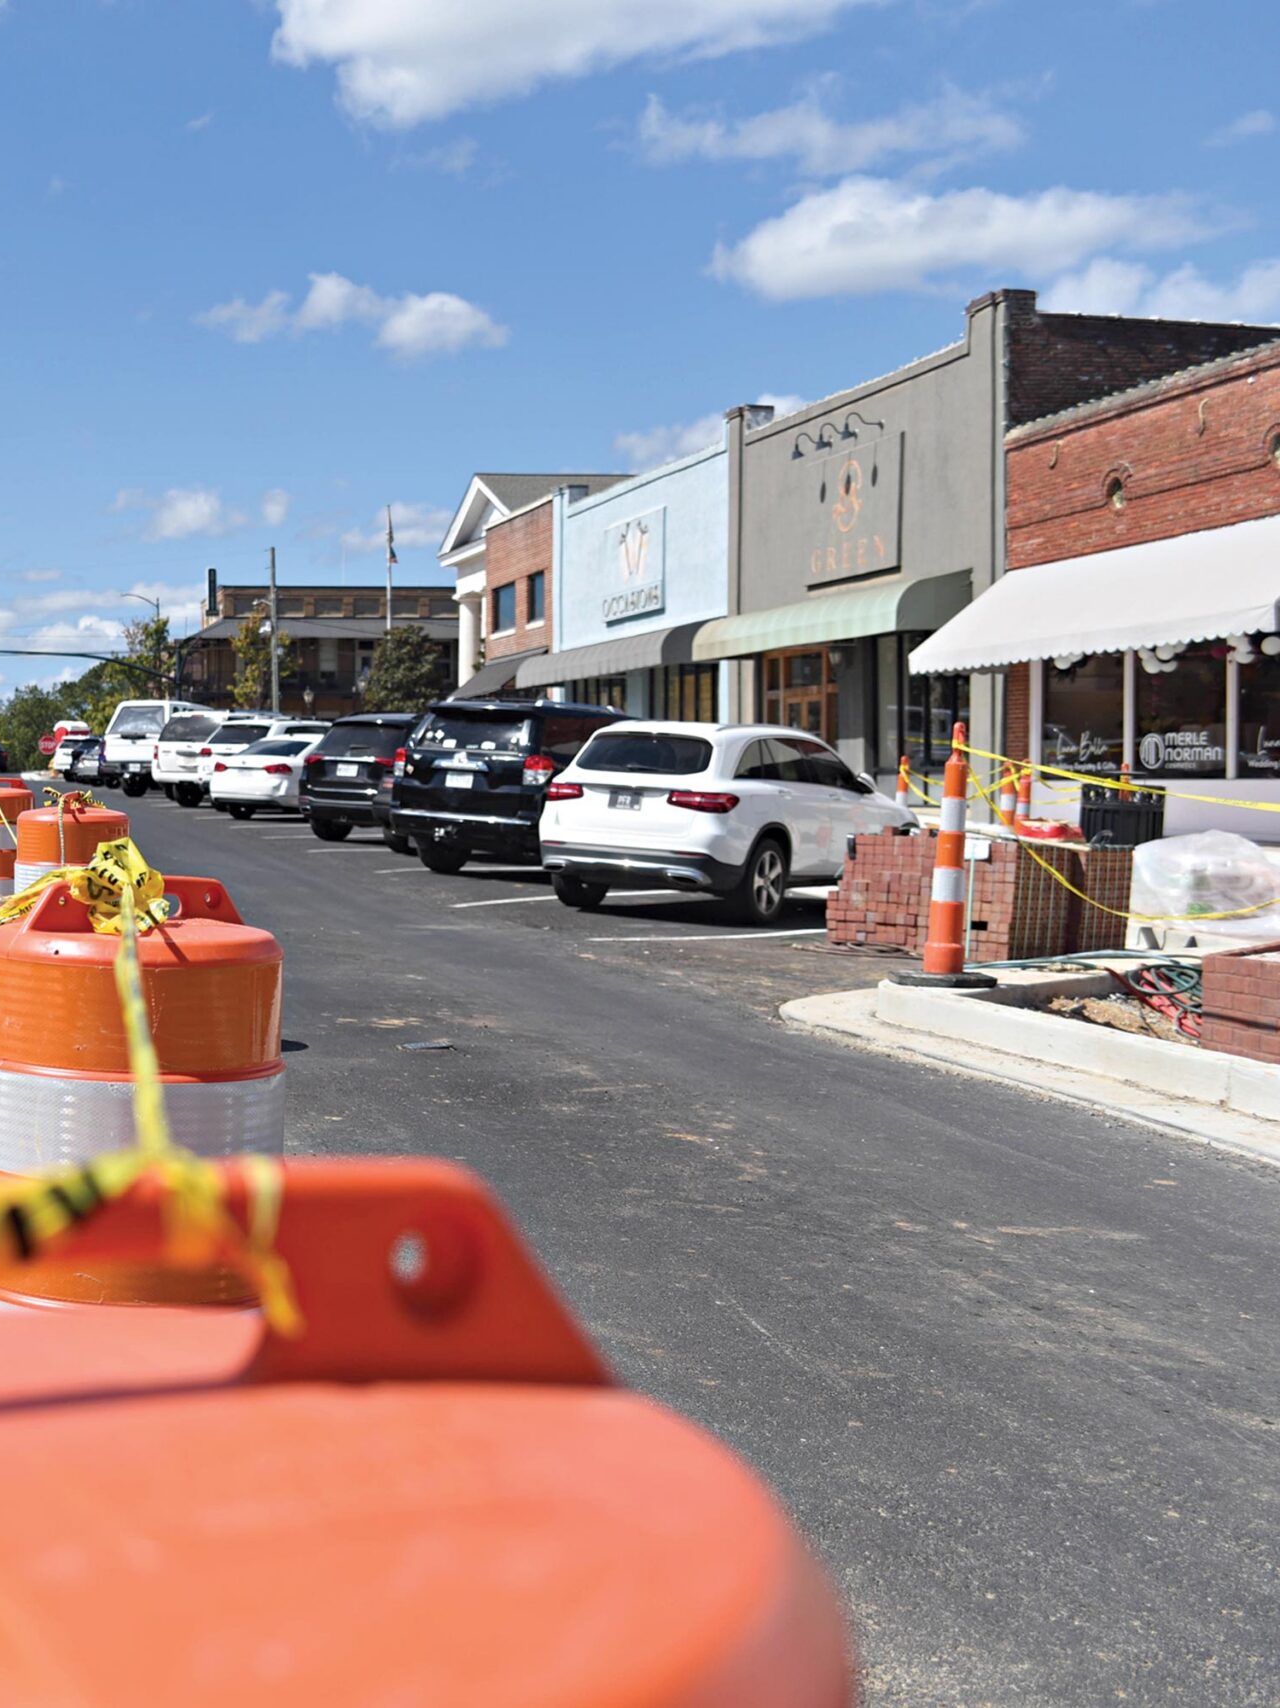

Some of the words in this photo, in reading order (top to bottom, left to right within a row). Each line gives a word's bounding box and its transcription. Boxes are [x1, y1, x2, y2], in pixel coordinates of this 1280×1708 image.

[602, 585, 660, 618] OCCASIONS
[39, 741, 56, 749] STOP
[1165, 732, 1208, 745] MERLE
[1165, 747, 1222, 761] NORMAN
